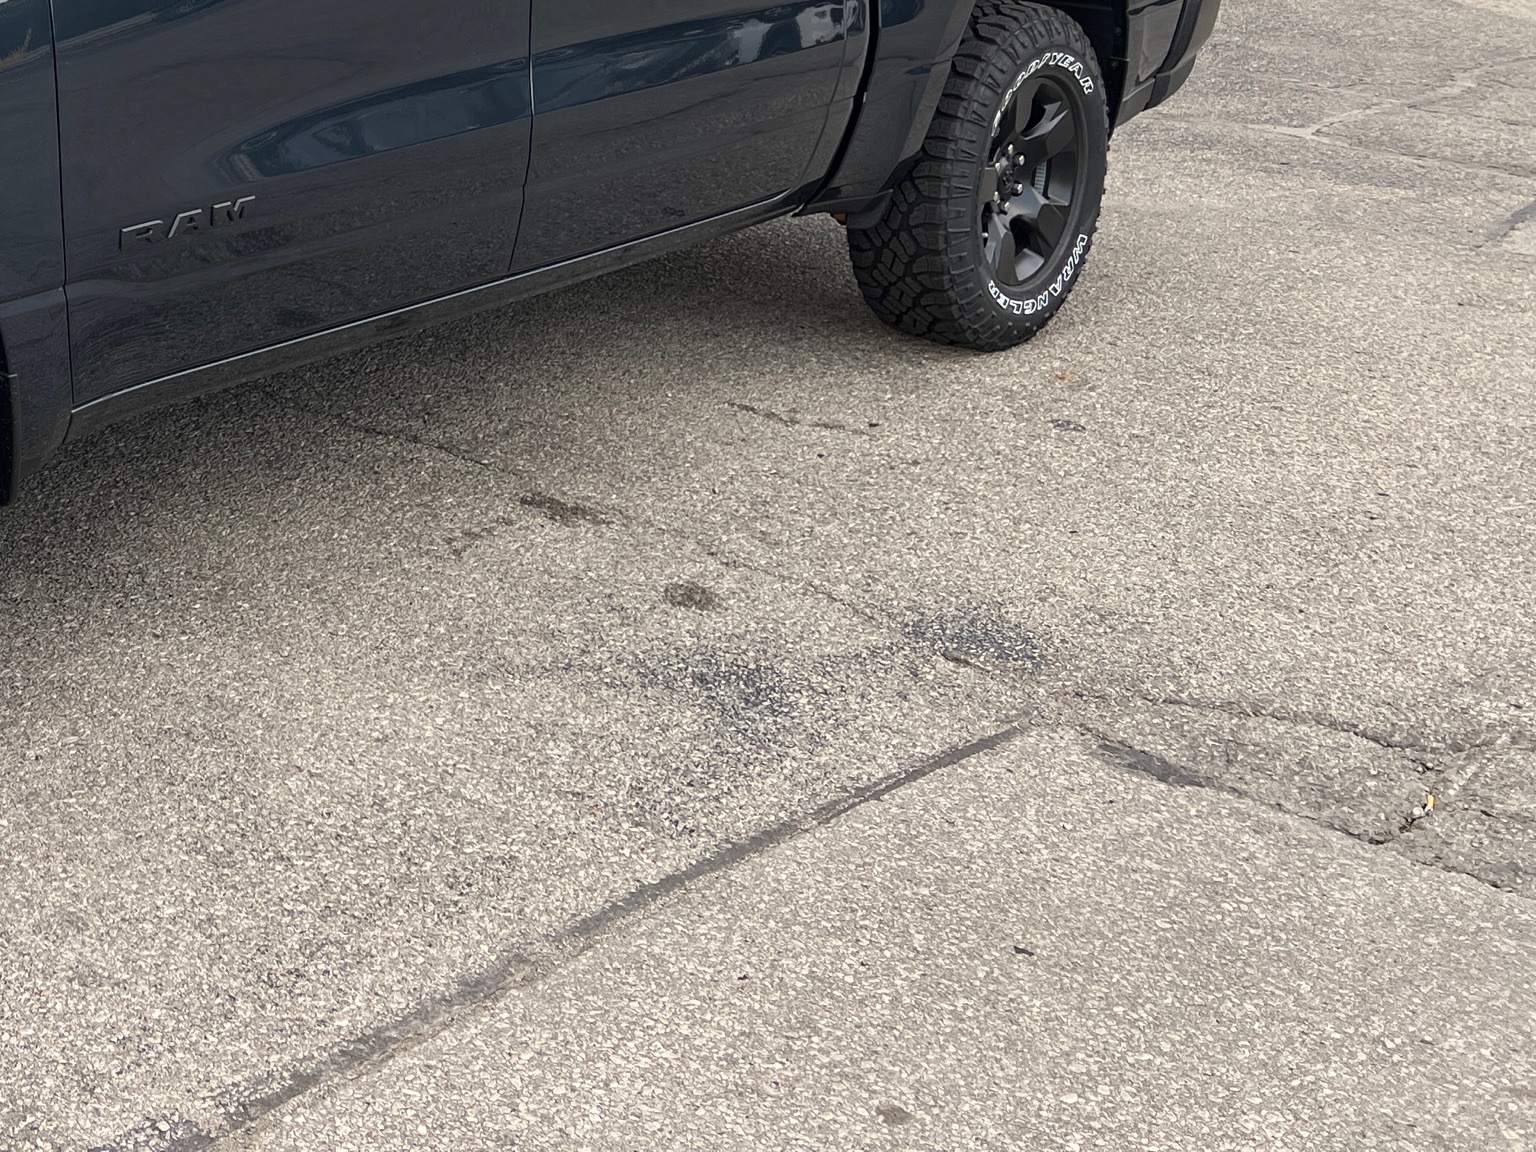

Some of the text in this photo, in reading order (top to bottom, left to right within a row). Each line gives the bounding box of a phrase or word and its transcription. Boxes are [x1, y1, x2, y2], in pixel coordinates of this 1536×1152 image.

[991, 51, 1095, 138] GOODYEAR
[118, 195, 257, 251] RAM
[986, 232, 1089, 316] WRANGLER
